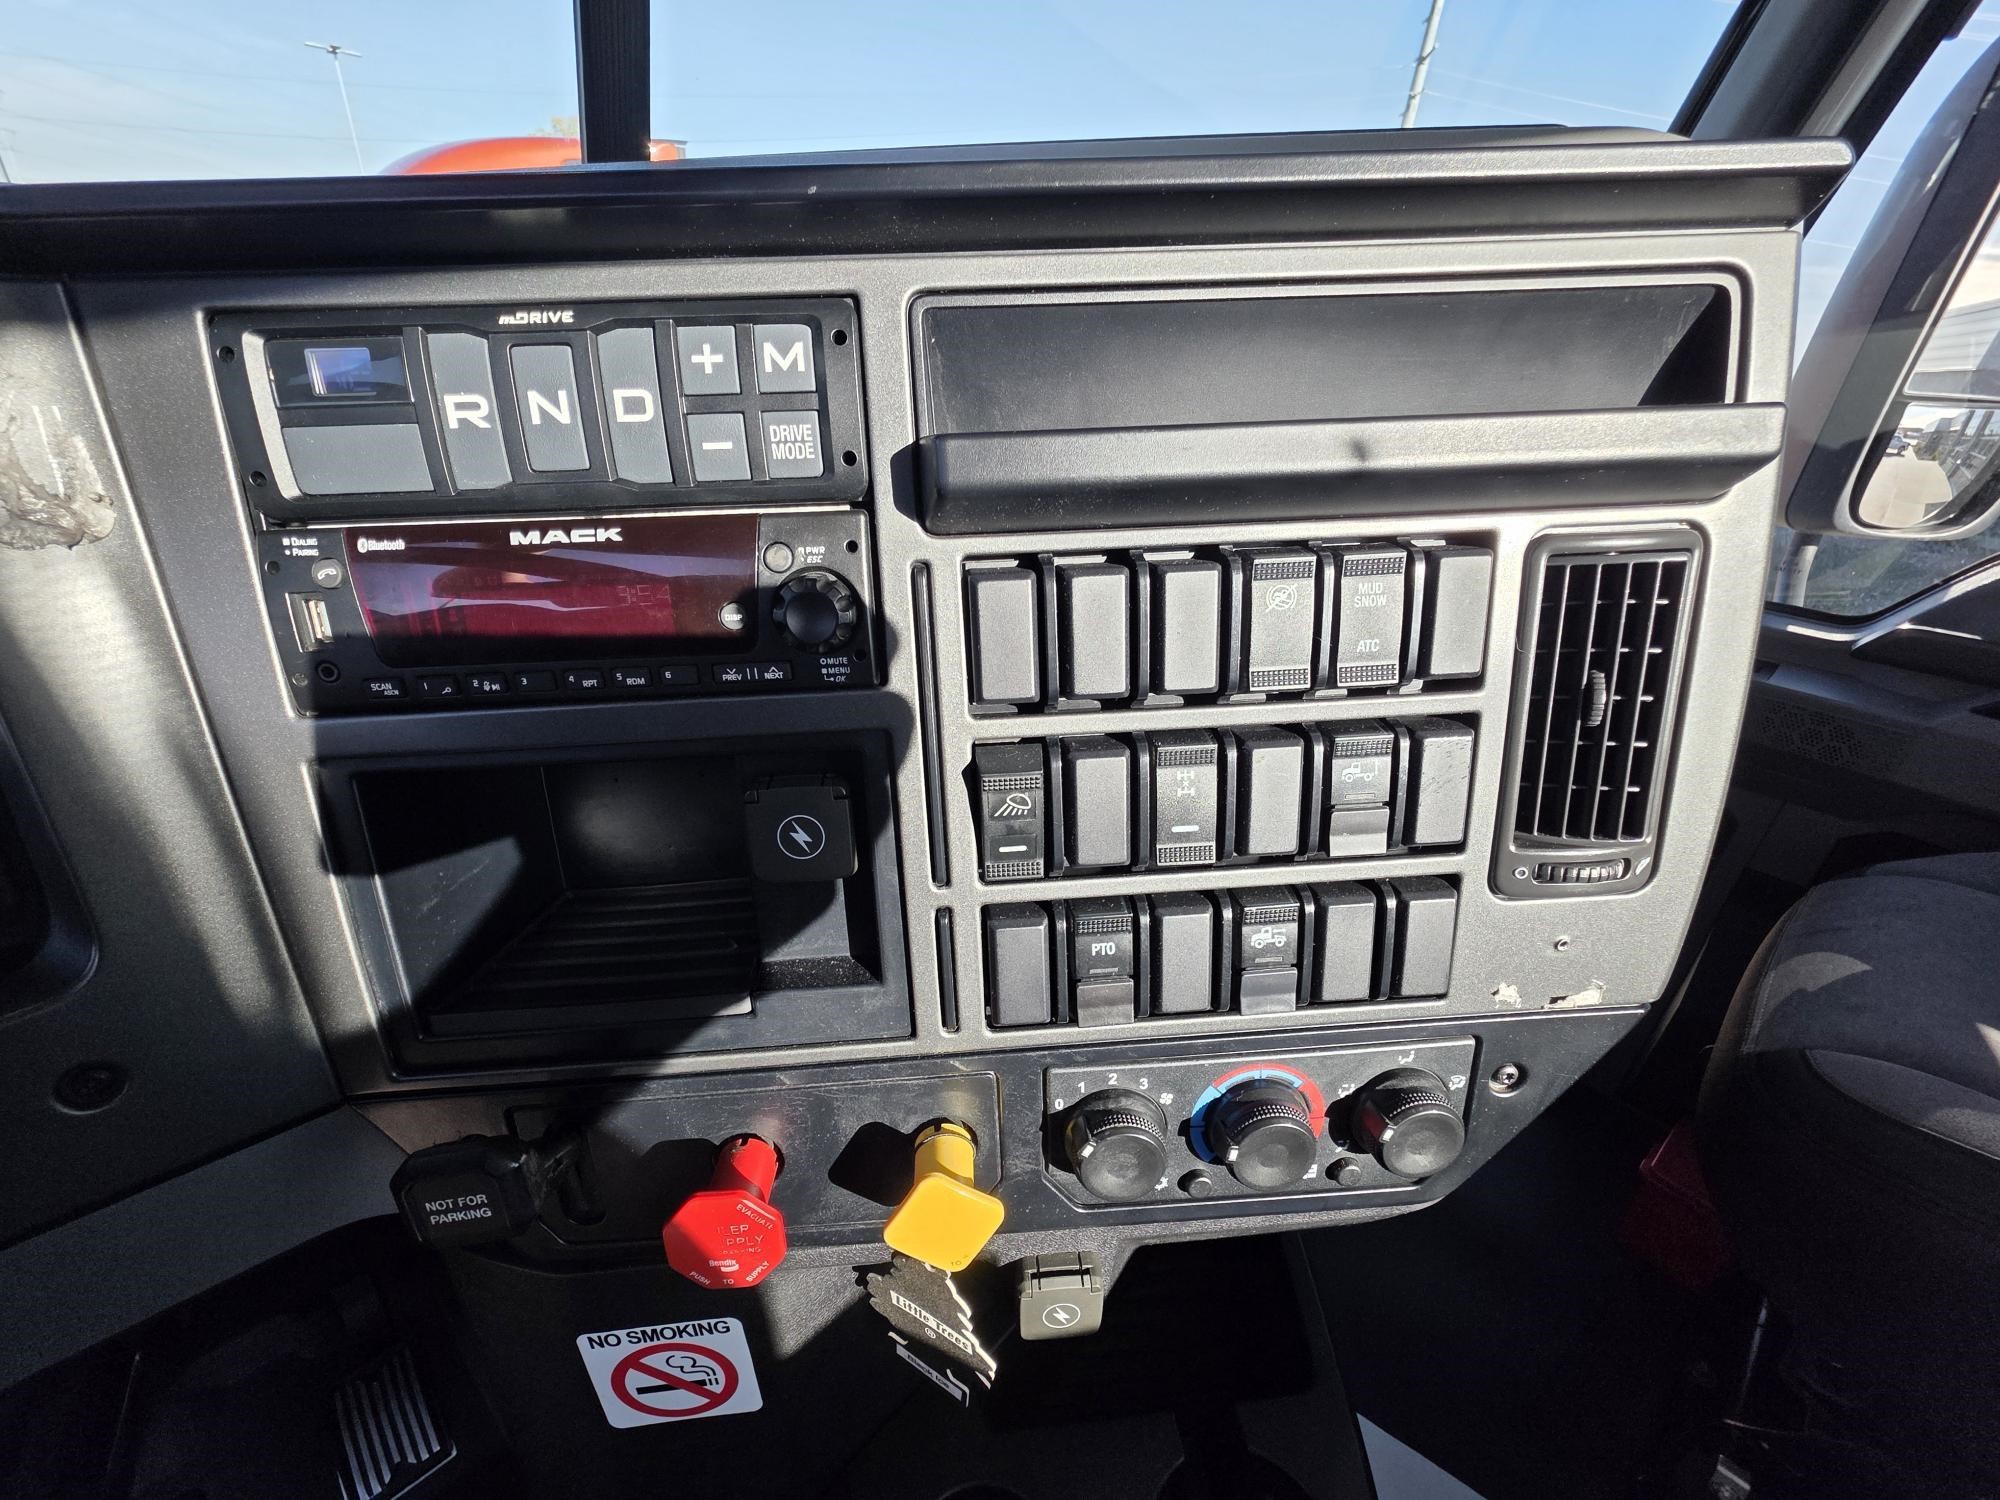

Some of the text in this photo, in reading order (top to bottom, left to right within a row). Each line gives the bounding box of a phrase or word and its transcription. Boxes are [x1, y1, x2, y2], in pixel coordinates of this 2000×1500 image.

[763, 341, 806, 373] M
[443, 393, 492, 430] R
[526, 388, 572, 425] N
[612, 387, 655, 423] D
[769, 424, 813, 442] DRIVE
[771, 442, 815, 460] MODE
[509, 528, 623, 546] MACK
[368, 539, 405, 551] Bluetooth
[805, 546, 825, 555] PWR
[806, 555, 824, 563] ESC
[1358, 582, 1384, 595] MUD
[1354, 594, 1387, 608] SNOW
[1356, 639, 1380, 653] ATC
[827, 657, 848, 665] MUTE
[616, 672, 623, 681] 5
[664, 671, 672, 679] 6
[764, 671, 784, 680] NEXT
[828, 666, 851, 674] MENU
[472, 679, 480, 687] 2
[520, 677, 527, 685] 3
[568, 675, 575, 683] 4
[582, 679, 598, 688] RPT
[626, 677, 646, 686] RDM
[370, 682, 393, 692] SCAN
[1091, 942, 1116, 956] PTO
[1054, 1072, 1149, 1110] 0 1 2 3
[424, 1194, 488, 1213] NOT FOR
[430, 1207, 492, 1225] PARKING
[709, 1259, 737, 1267] Bendix
[689, 1271, 711, 1286] PUSH
[745, 1261, 770, 1282] SUPPLY
[895, 1295, 969, 1350] Little Trees
[586, 1320, 731, 1350] NO SMOKING
